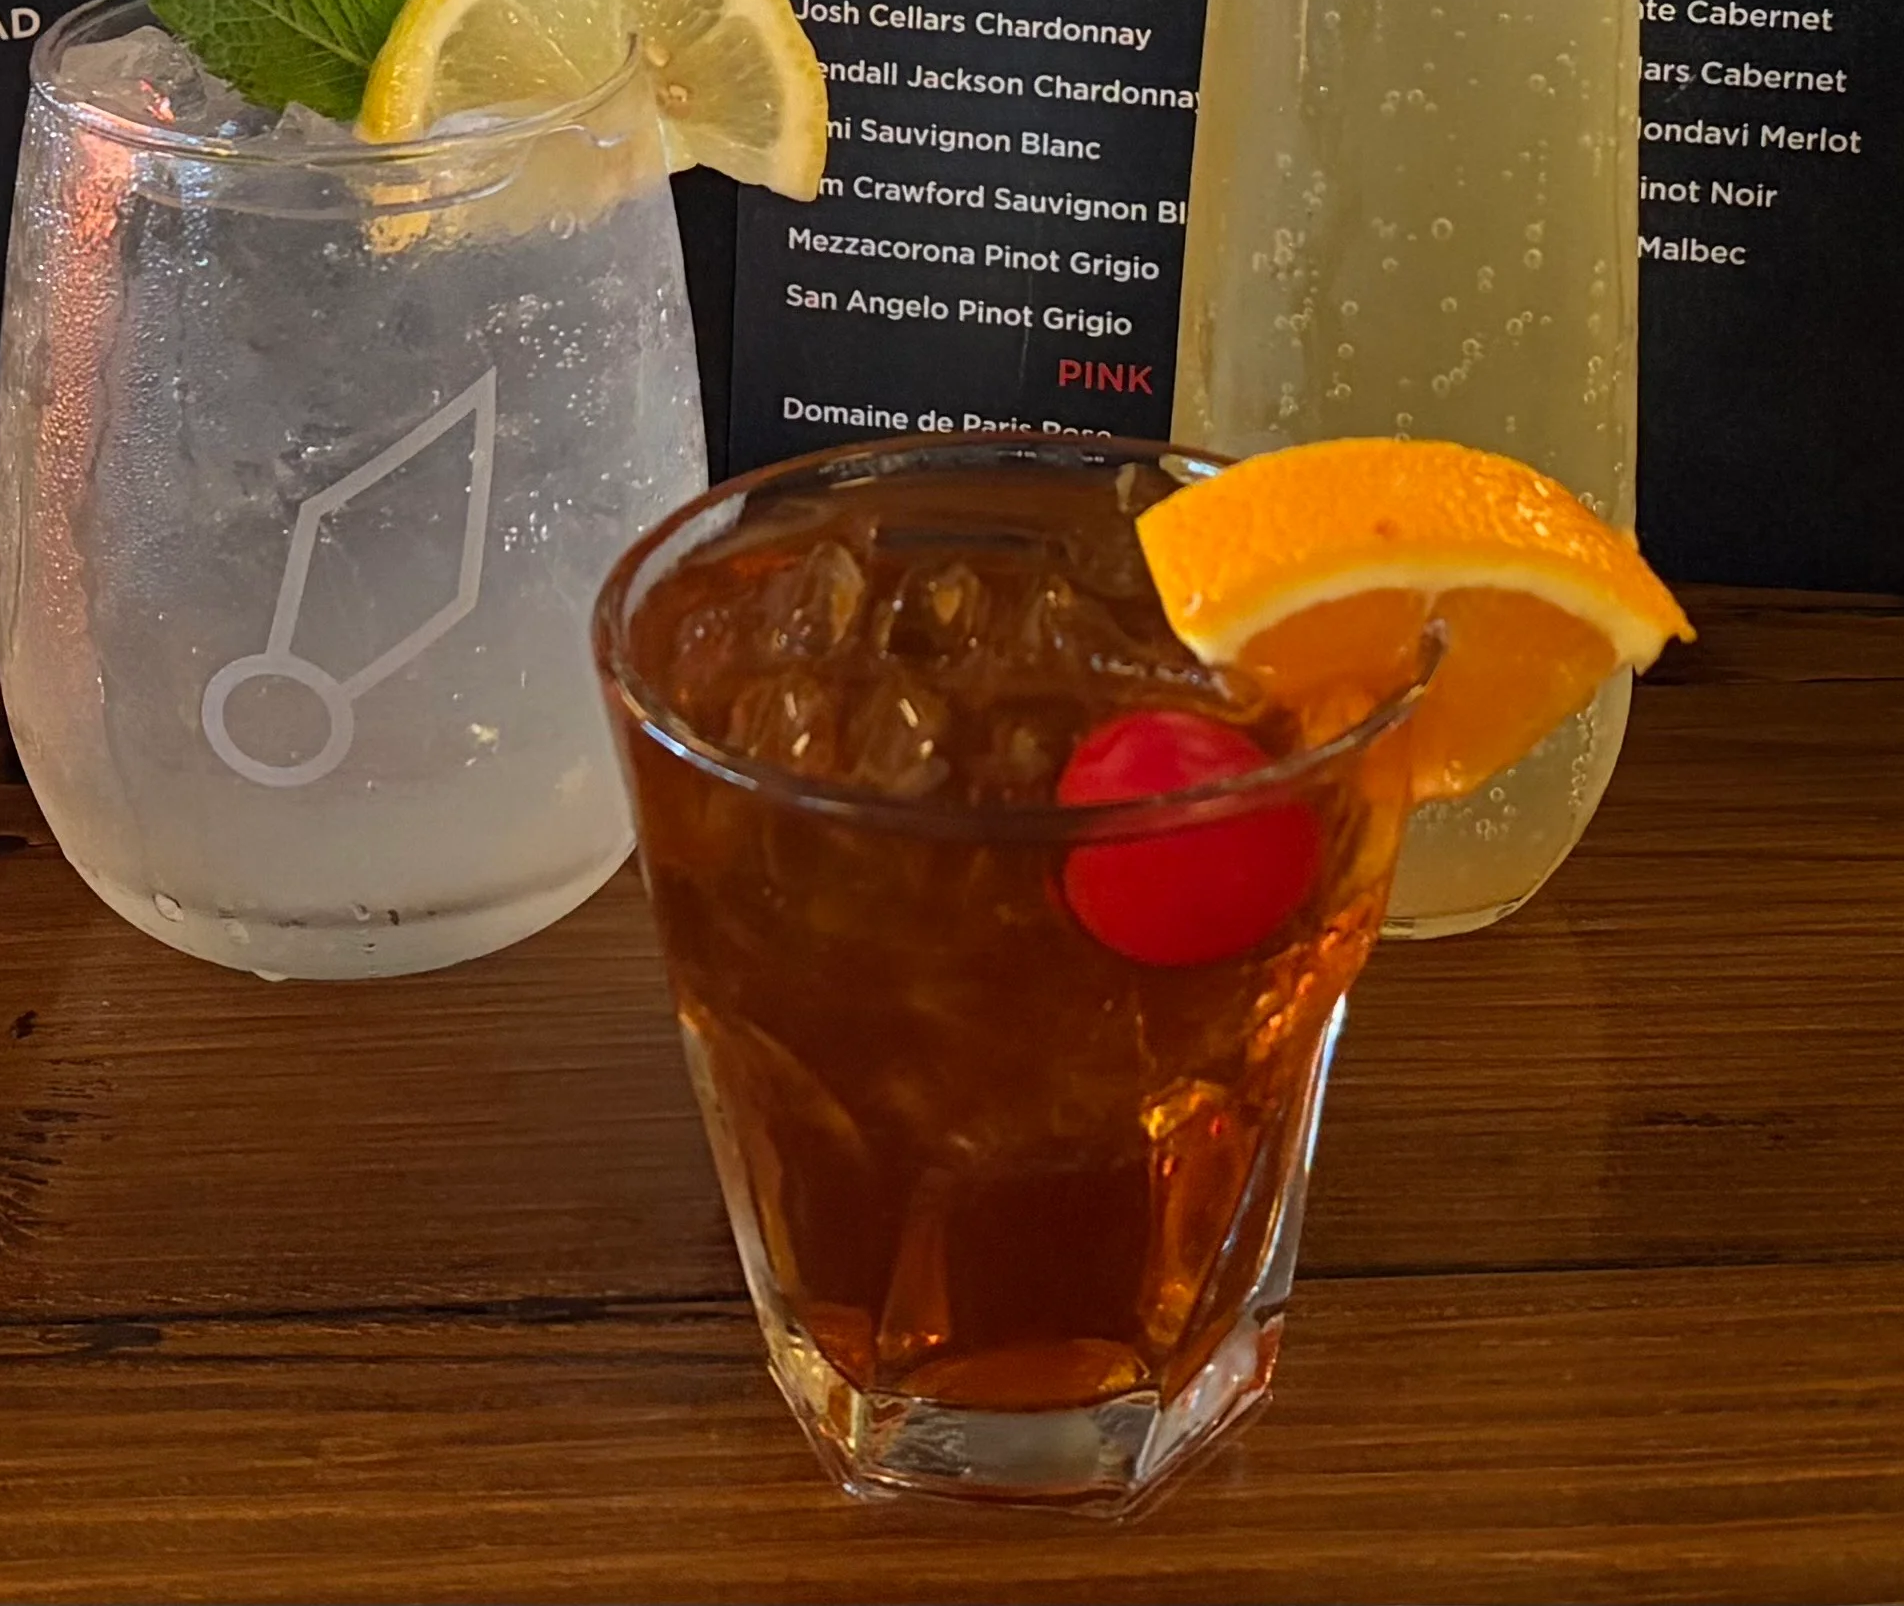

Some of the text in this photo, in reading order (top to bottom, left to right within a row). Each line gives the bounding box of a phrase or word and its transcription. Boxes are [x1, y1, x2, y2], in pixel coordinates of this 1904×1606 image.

[869, 3, 966, 33] Cellars
[975, 11, 1152, 51] Chardonnay
[1686, 0, 1834, 32] Cabernet
[1700, 61, 1848, 93] Cabernet
[1760, 124, 1862, 154] Merlot
[1710, 181, 1778, 208] Noir
[788, 226, 1160, 283] Mezzacorona Pinot Grigio
[1637, 235, 1746, 265] Malbec
[786, 283, 1133, 338] San Angelo Pinot Grigio
[1058, 359, 1153, 395] PINK
[783, 396, 954, 433] Domaine de
